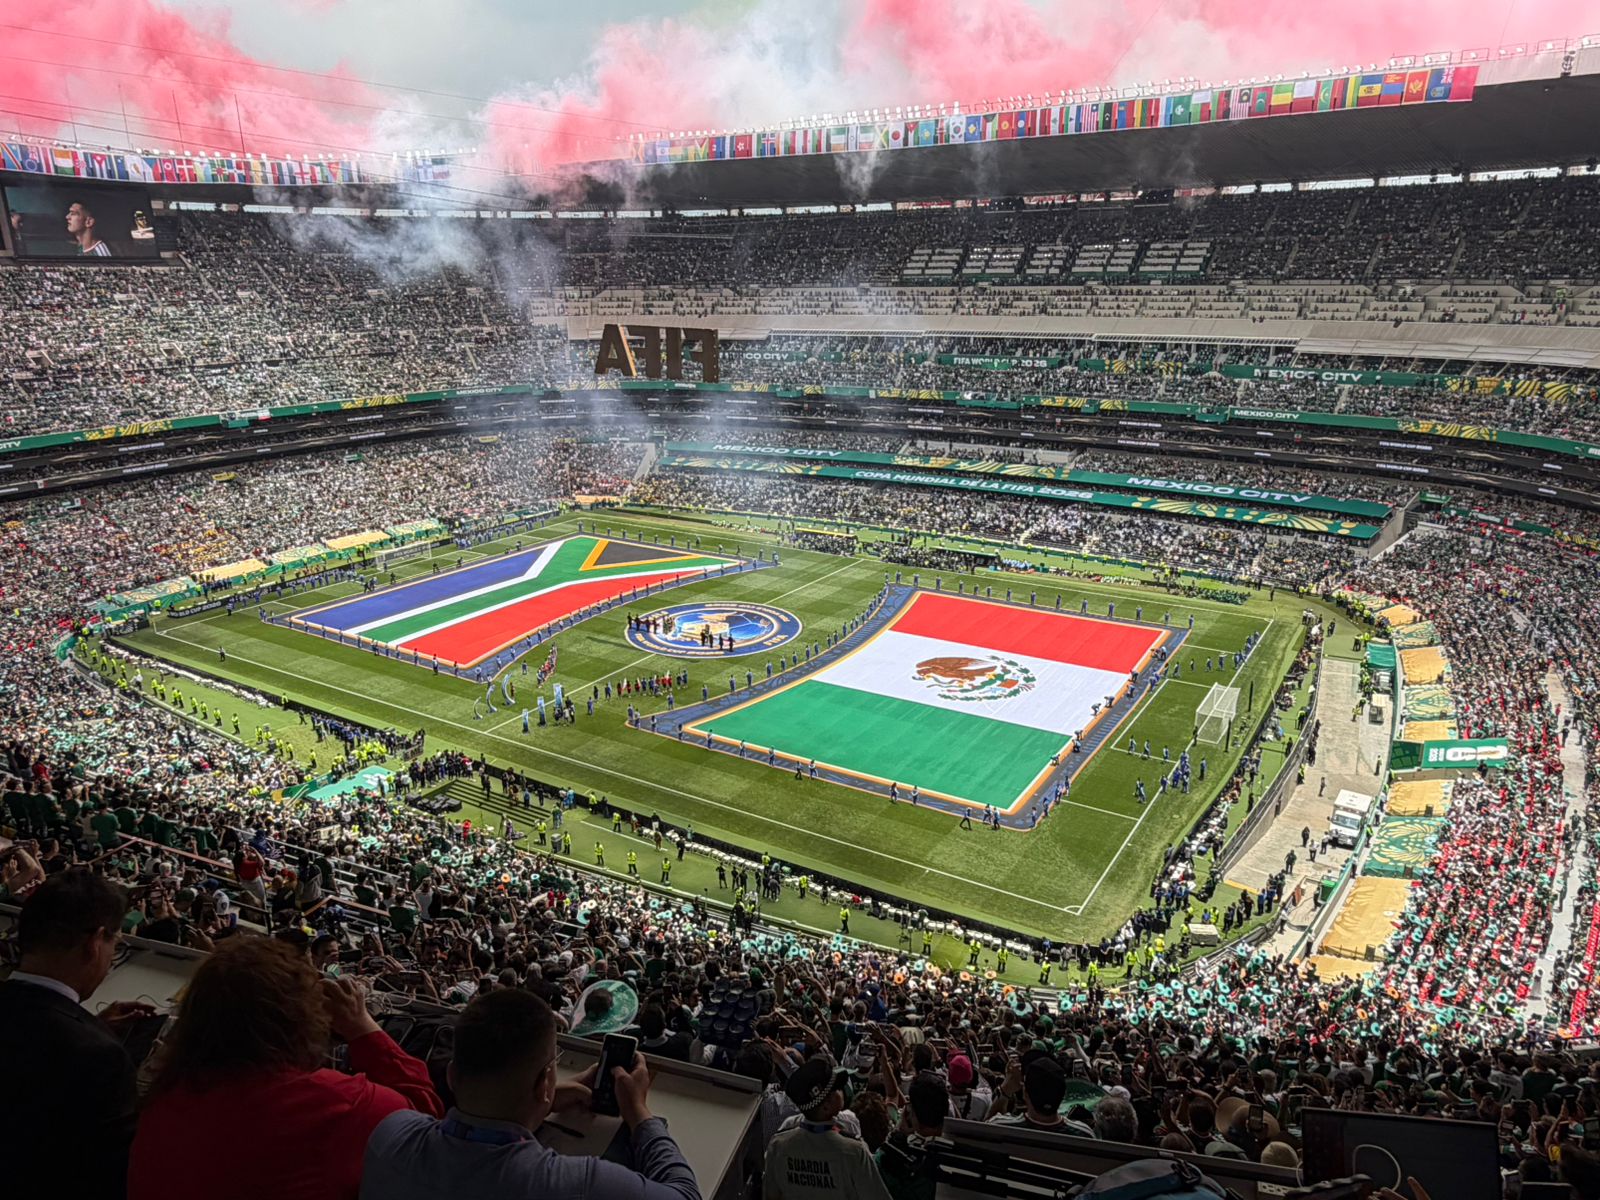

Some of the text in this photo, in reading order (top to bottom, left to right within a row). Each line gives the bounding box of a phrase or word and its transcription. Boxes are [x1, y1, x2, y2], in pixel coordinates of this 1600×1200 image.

[953, 357, 971, 365] FIFA
[1321, 371, 1363, 381] CITY
[1234, 409, 1300, 419] MEXICO CITY
[712, 444, 843, 457] MEXICO CITY
[855, 470, 1094, 500] COPA MUNDIAL DE LA FIFA 2026
[1126, 476, 1312, 503] MEXICO CITY
[787, 1156, 831, 1175] GUARDIA
[786, 1170, 837, 1189] NACIONAL
